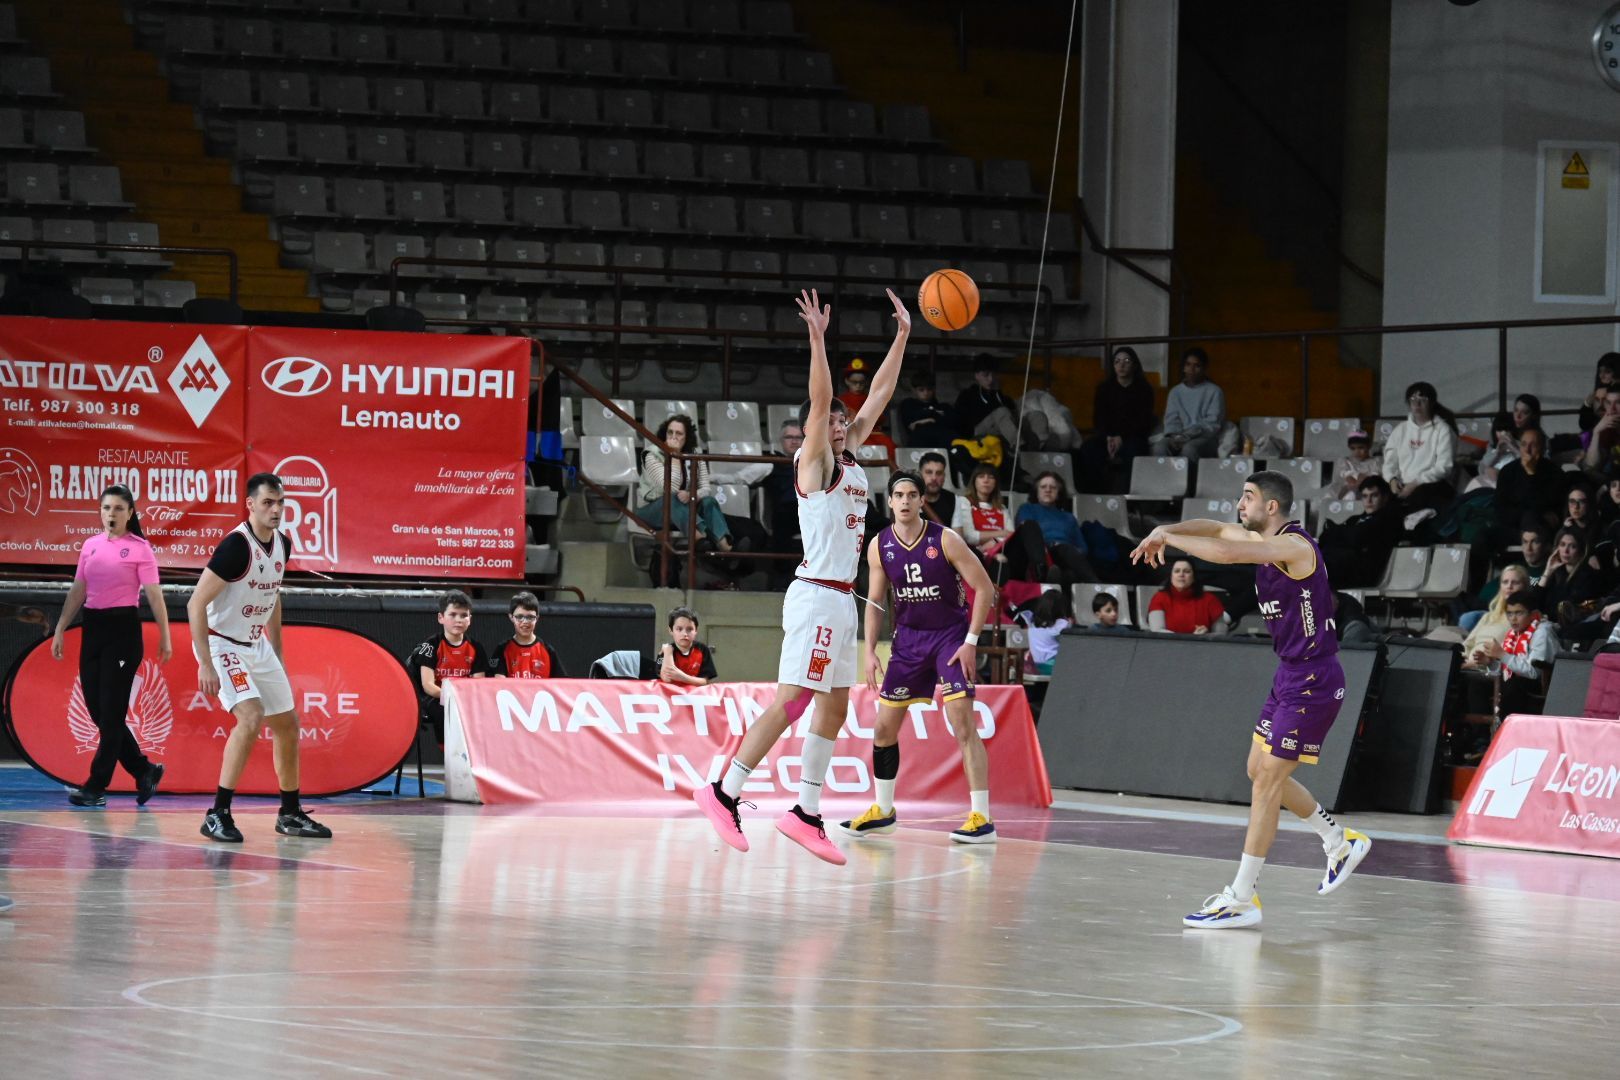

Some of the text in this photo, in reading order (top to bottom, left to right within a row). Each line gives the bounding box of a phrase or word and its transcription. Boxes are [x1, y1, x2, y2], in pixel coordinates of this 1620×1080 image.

[1604, 41, 1613, 51] 9
[1609, 57, 1617, 68] 8
[0, 360, 160, 393] ATILVA
[342, 364, 514, 399] HYUNDAI
[3, 398, 140, 416] Telf. 987 300 318
[8, 418, 134, 431] E-mail: atilvaleon@hotmail.com
[341, 405, 460, 431] Lemauto
[98, 448, 189, 465] RESTAURANTE
[437, 467, 515, 482] La mayor oferta
[49, 464, 238, 503] RANCHO CHICO III
[414, 482, 515, 495] inmobiliaria de León
[64, 525, 75, 534] Tu
[146, 526, 224, 537] León desde 1979
[279, 498, 322, 553] R3
[392, 524, 514, 537] Gran vía de San Marcos, 19
[34, 539, 71, 552] Álvarez
[170, 544, 190, 554] 987
[193, 545, 206, 555] 26
[436, 537, 515, 549] Telfs: 987 222 333
[372, 554, 513, 568] www.inmobiliariar3.com
[903, 563, 923, 584] 12
[896, 585, 940, 599] UEMC
[249, 625, 264, 641] 33
[816, 625, 833, 647] 13
[220, 652, 241, 667] 33
[657, 753, 871, 793] IVECO
[1559, 810, 1580, 829] Las
[1581, 812, 1617, 833] Casas
